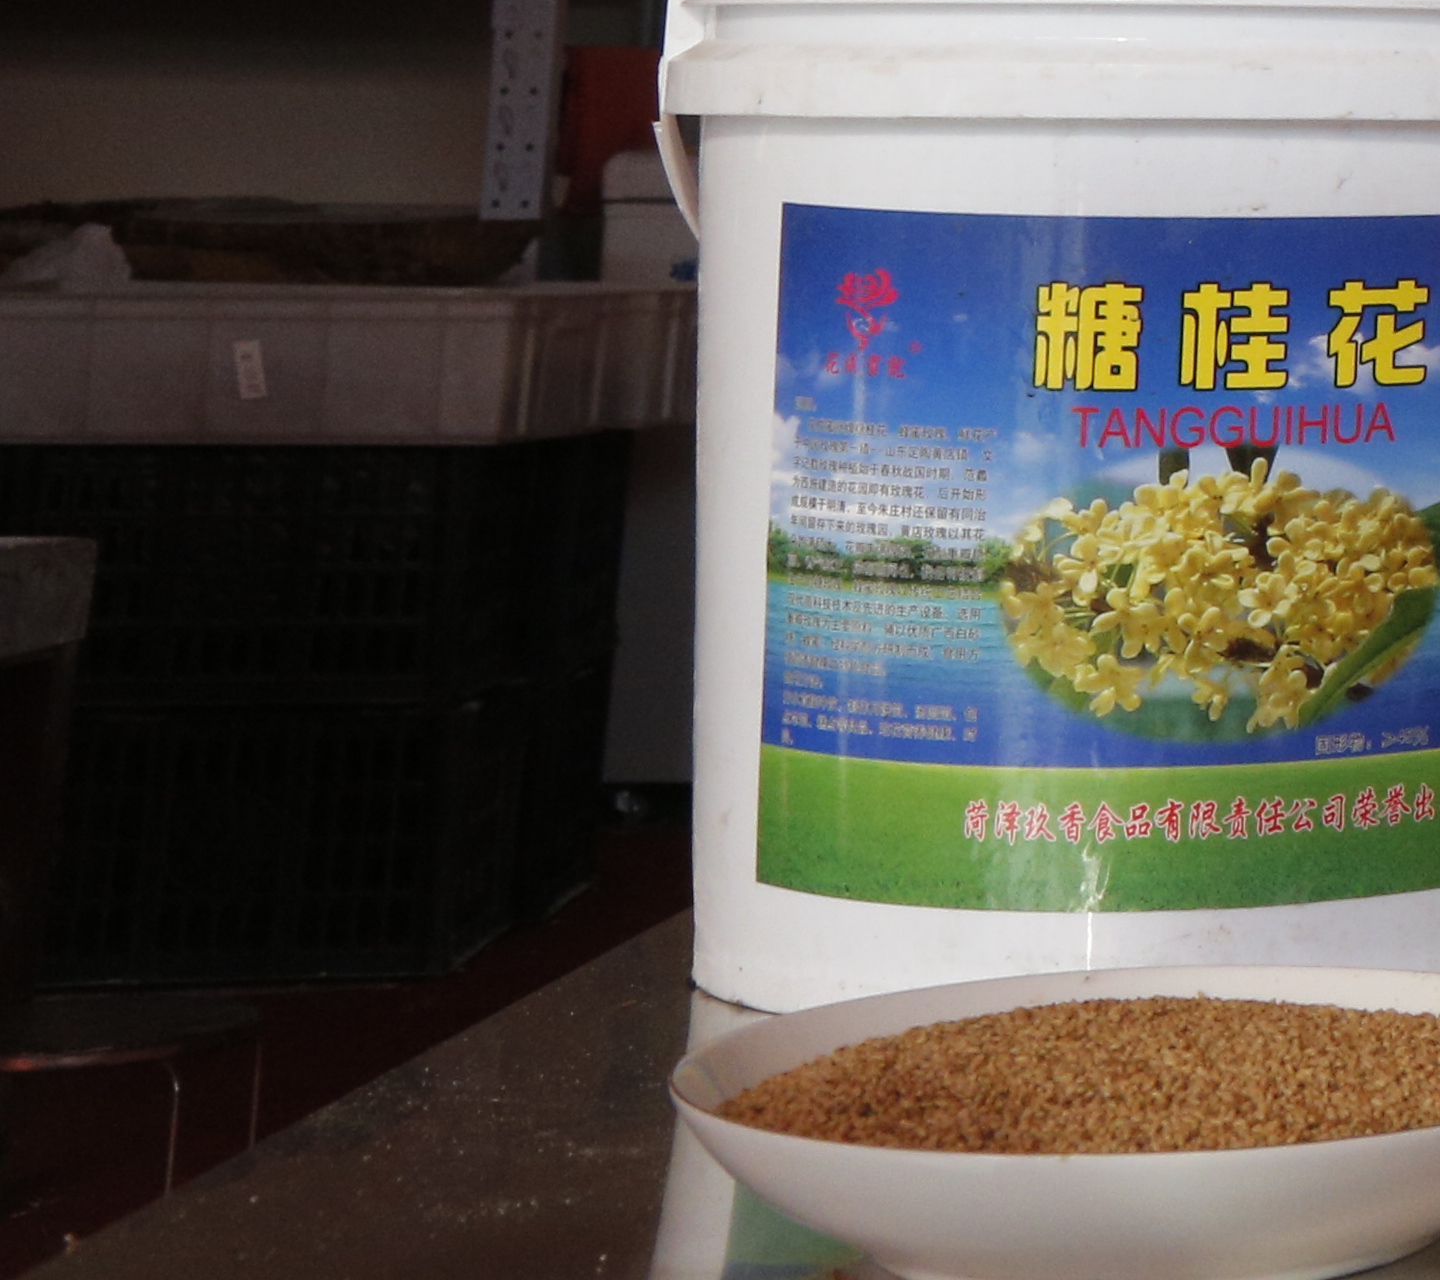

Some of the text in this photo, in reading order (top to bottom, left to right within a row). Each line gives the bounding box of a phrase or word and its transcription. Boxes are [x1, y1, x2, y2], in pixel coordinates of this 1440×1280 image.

[1034, 278, 1430, 392] 糖桂花
[1070, 403, 1397, 448] TANGGUIHUA
